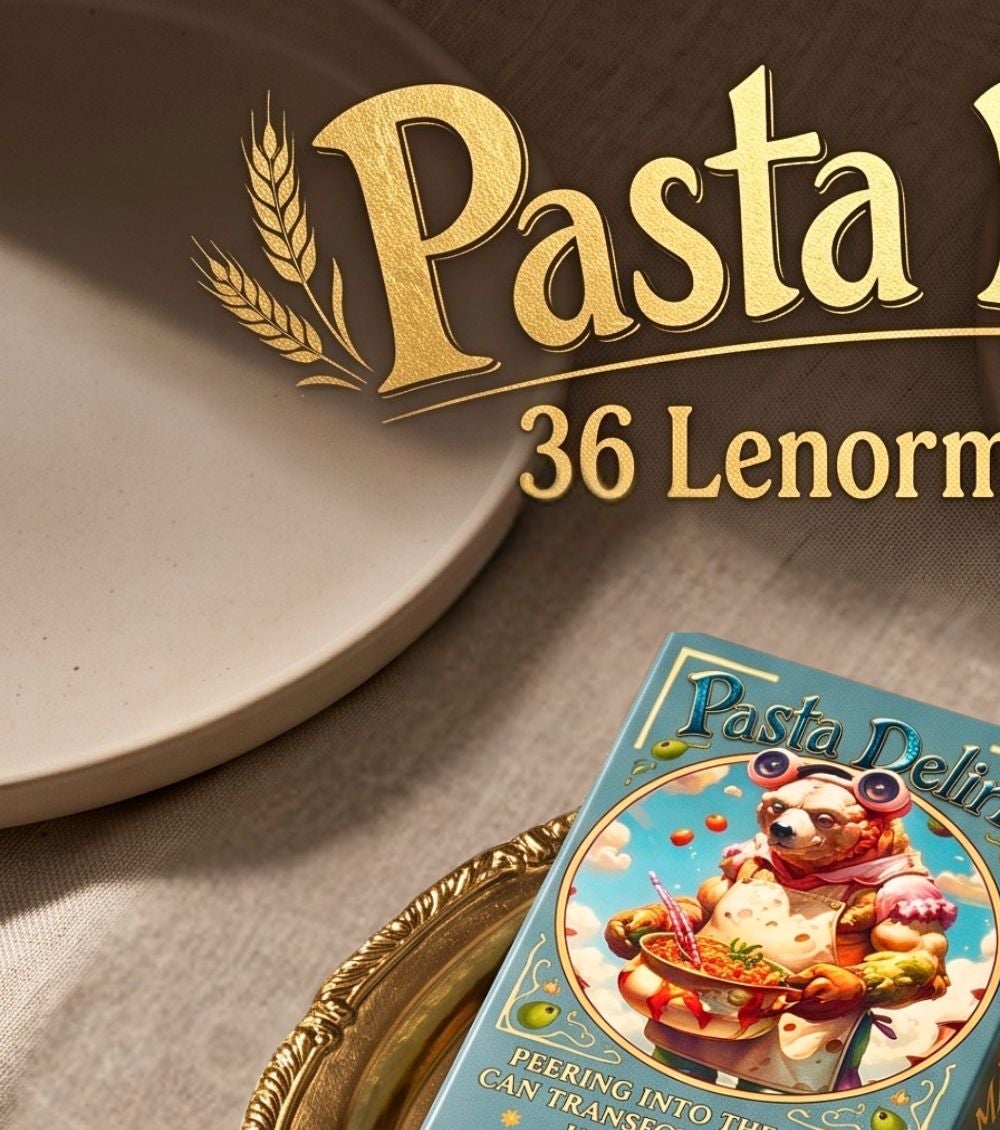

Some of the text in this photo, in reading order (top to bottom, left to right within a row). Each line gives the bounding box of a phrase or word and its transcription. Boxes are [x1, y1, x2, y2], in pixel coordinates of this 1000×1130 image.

[677, 670, 842, 758] Pasta
[478, 1068, 542, 1100] CAN
[508, 1047, 633, 1101] PEERING
[638, 1087, 712, 1126] INTO
